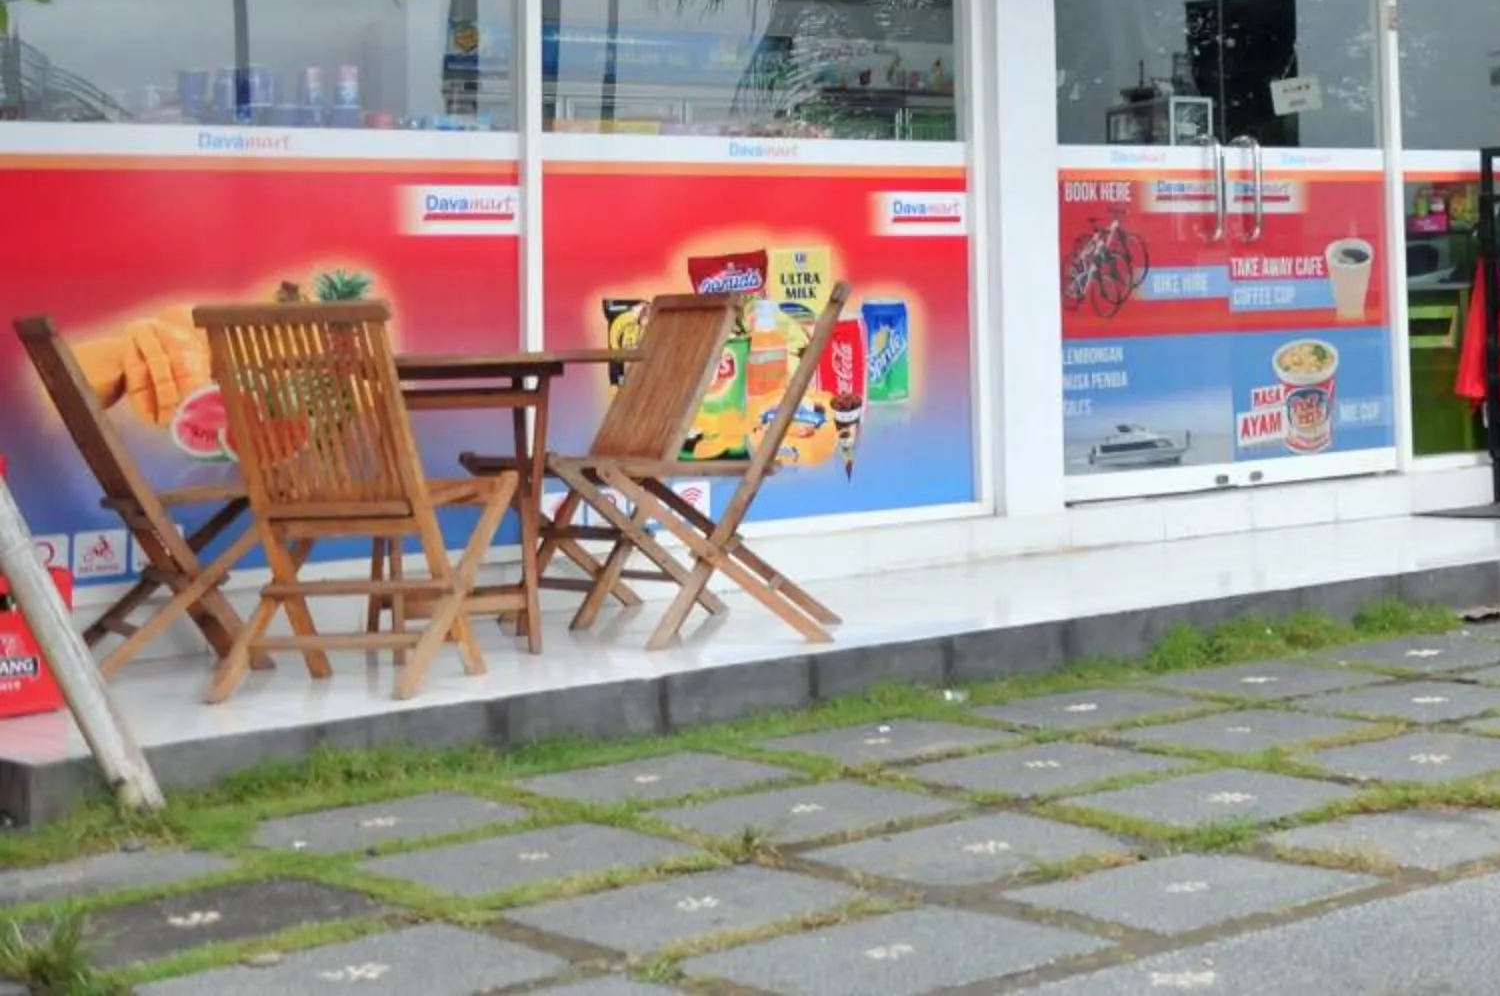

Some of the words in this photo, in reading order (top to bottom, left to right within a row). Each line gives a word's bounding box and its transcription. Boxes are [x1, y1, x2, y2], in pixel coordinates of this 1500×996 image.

[197, 132, 291, 151] Davamart
[729, 142, 798, 158] Davamart
[1064, 182, 1098, 203] BOOK
[1101, 181, 1132, 202] HERE
[425, 193, 515, 212] Davamart
[893, 200, 961, 215] Davamart
[1231, 258, 1260, 277] TAKE
[1262, 256, 1294, 276] AWAY
[1295, 255, 1325, 275] CAFE
[780, 272, 821, 286] ULTRA
[1152, 273, 1181, 294] BIKE
[1182, 273, 1209, 293] HIRE
[785, 287, 817, 300] MILK
[1233, 285, 1272, 305] COFFEE
[1274, 284, 1296, 303] CUP
[1241, 411, 1283, 438] AYAM
